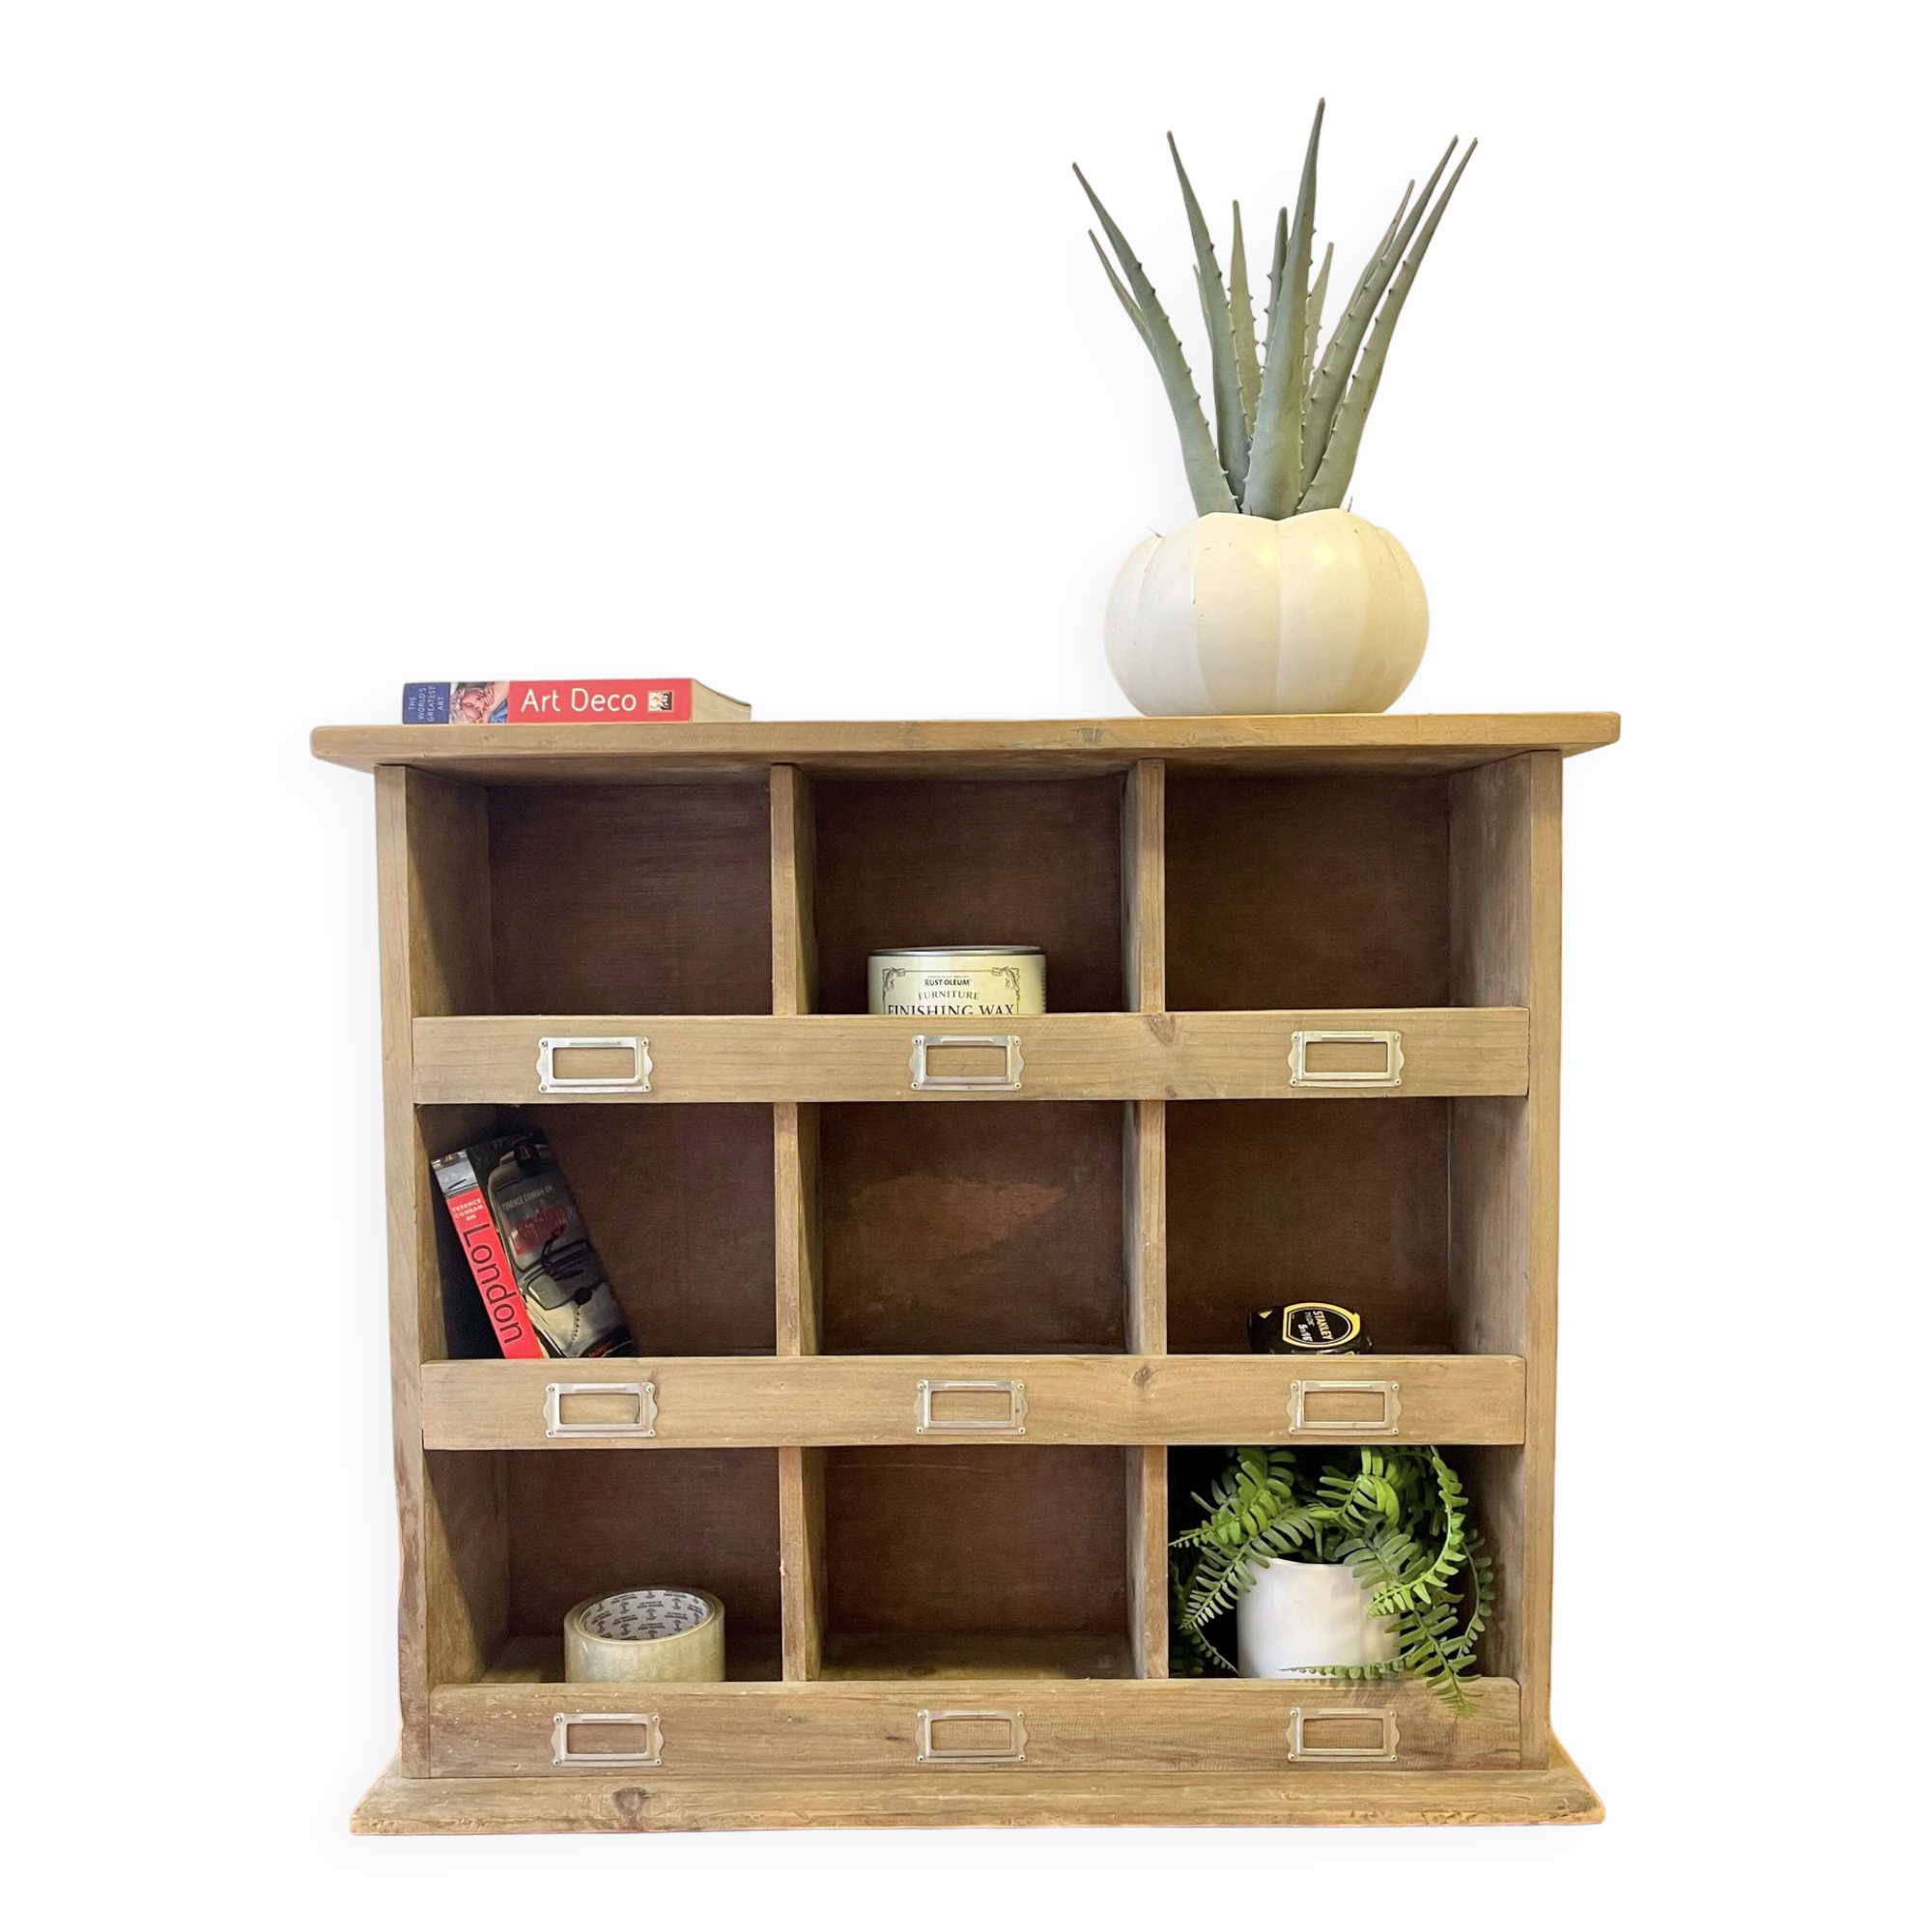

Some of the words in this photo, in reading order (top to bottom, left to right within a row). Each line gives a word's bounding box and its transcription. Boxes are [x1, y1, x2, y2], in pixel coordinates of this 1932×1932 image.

[408, 696, 416, 710] THE
[417, 687, 427, 721] WORLD'S
[426, 686, 437, 723] GREATEST
[437, 696, 445, 711] ART
[520, 689, 560, 713] Art
[570, 687, 638, 713] Deco
[918, 990, 980, 1001] FURNITURE
[887, 1004, 974, 1015] FINISHING
[979, 1004, 1014, 1015] WAX
[452, 1198, 482, 1213] TERENCE
[454, 1204, 483, 1219] CONRAN
[466, 1213, 477, 1222] ON
[463, 1222, 524, 1344] London
[1313, 1310, 1334, 1340] STANLEY
